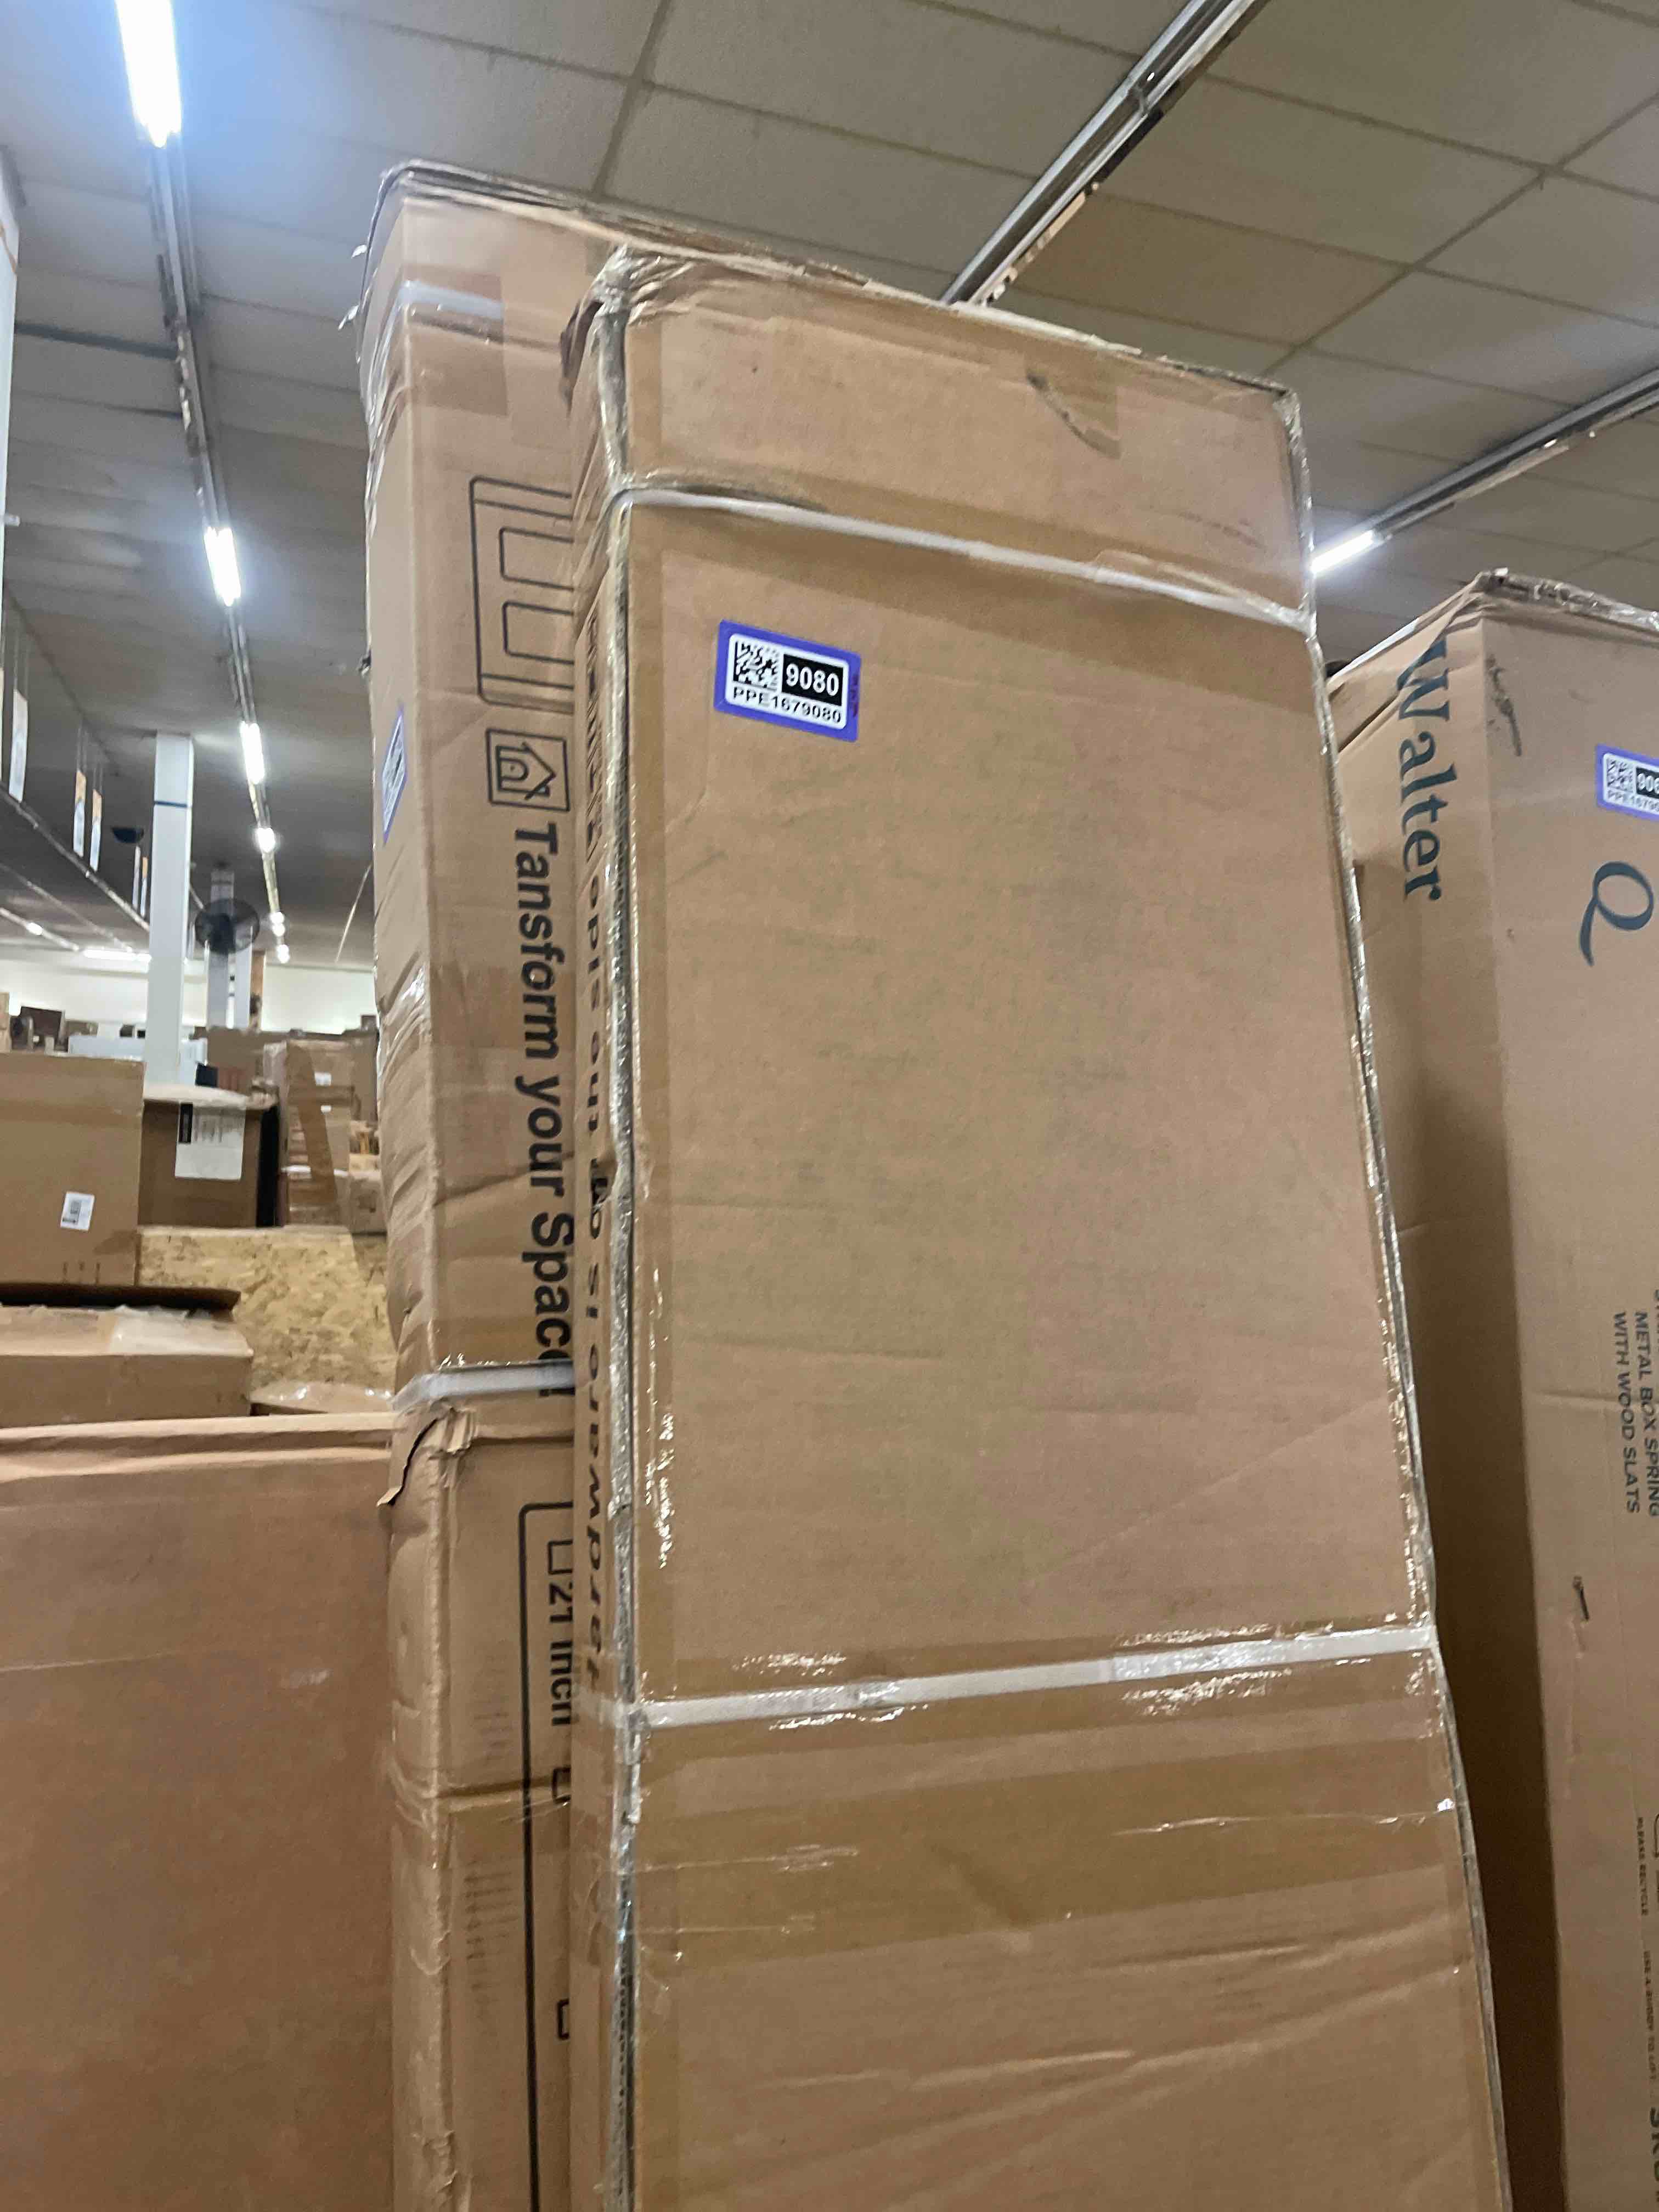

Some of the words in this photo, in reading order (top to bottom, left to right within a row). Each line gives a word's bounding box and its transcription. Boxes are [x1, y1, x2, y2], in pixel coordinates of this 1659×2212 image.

[733, 686, 842, 723] PPE1679080
[785, 663, 839, 696] 9080
[1397, 635, 1457, 901] Walter
[515, 823, 566, 1059] Tansform
[588, 875, 600, 1012] side
[1579, 861, 1654, 966] Q
[588, 1031, 599, 1133] the
[514, 1075, 565, 1198] your
[521, 1212, 575, 1398] Spac!
[586, 1262, 599, 1319] is
[1614, 1311, 1630, 1365] WITH
[1633, 1311, 1652, 1380] METAL
[1618, 1371, 1635, 1441] WOOD
[1640, 1386, 1656, 1432] BOX
[1623, 1447, 1640, 1513] SLATS
[1644, 1437, 1659, 1517] SPRING
[549, 1581, 573, 1623] 21
